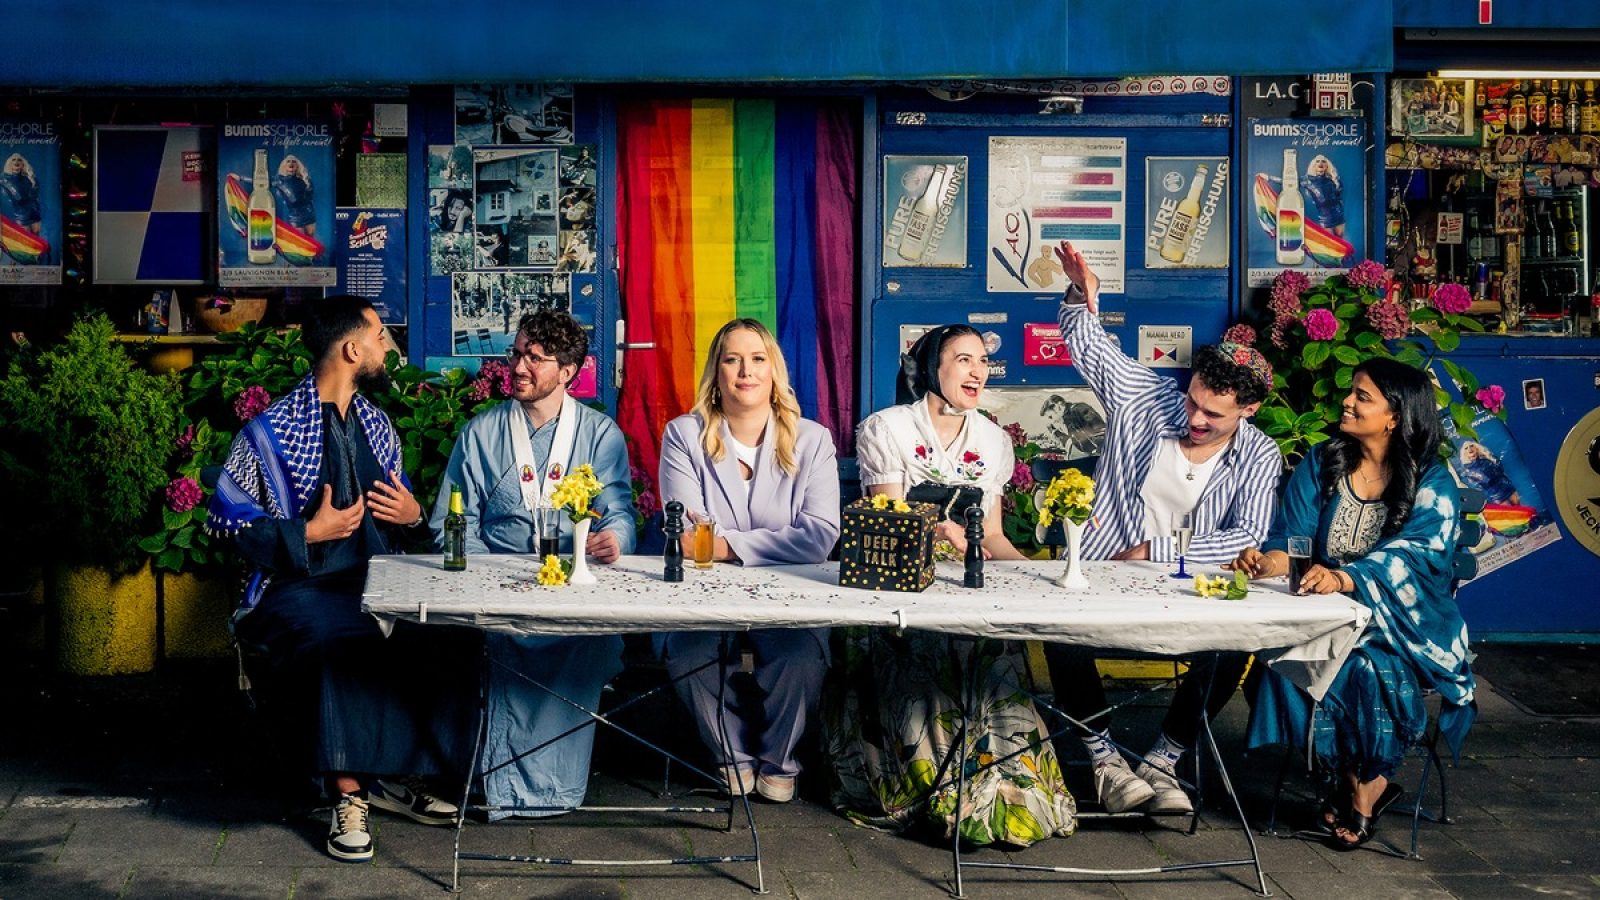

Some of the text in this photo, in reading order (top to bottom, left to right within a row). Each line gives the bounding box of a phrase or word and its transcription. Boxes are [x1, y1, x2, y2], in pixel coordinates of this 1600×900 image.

[1151, 83, 1162, 91] 40
[224, 124, 328, 137] BUMMSSCHORLE
[1254, 123, 1358, 137] BUMMSSCHORLE
[923, 162, 966, 264] ERFRISCHUNG
[1183, 162, 1228, 265] ERFRISCHUNG
[886, 194, 917, 250] PURE
[1147, 196, 1178, 251] PURE
[1171, 219, 1190, 233] FASS
[863, 534, 899, 551] DEEP
[863, 550, 897, 568] TALK
